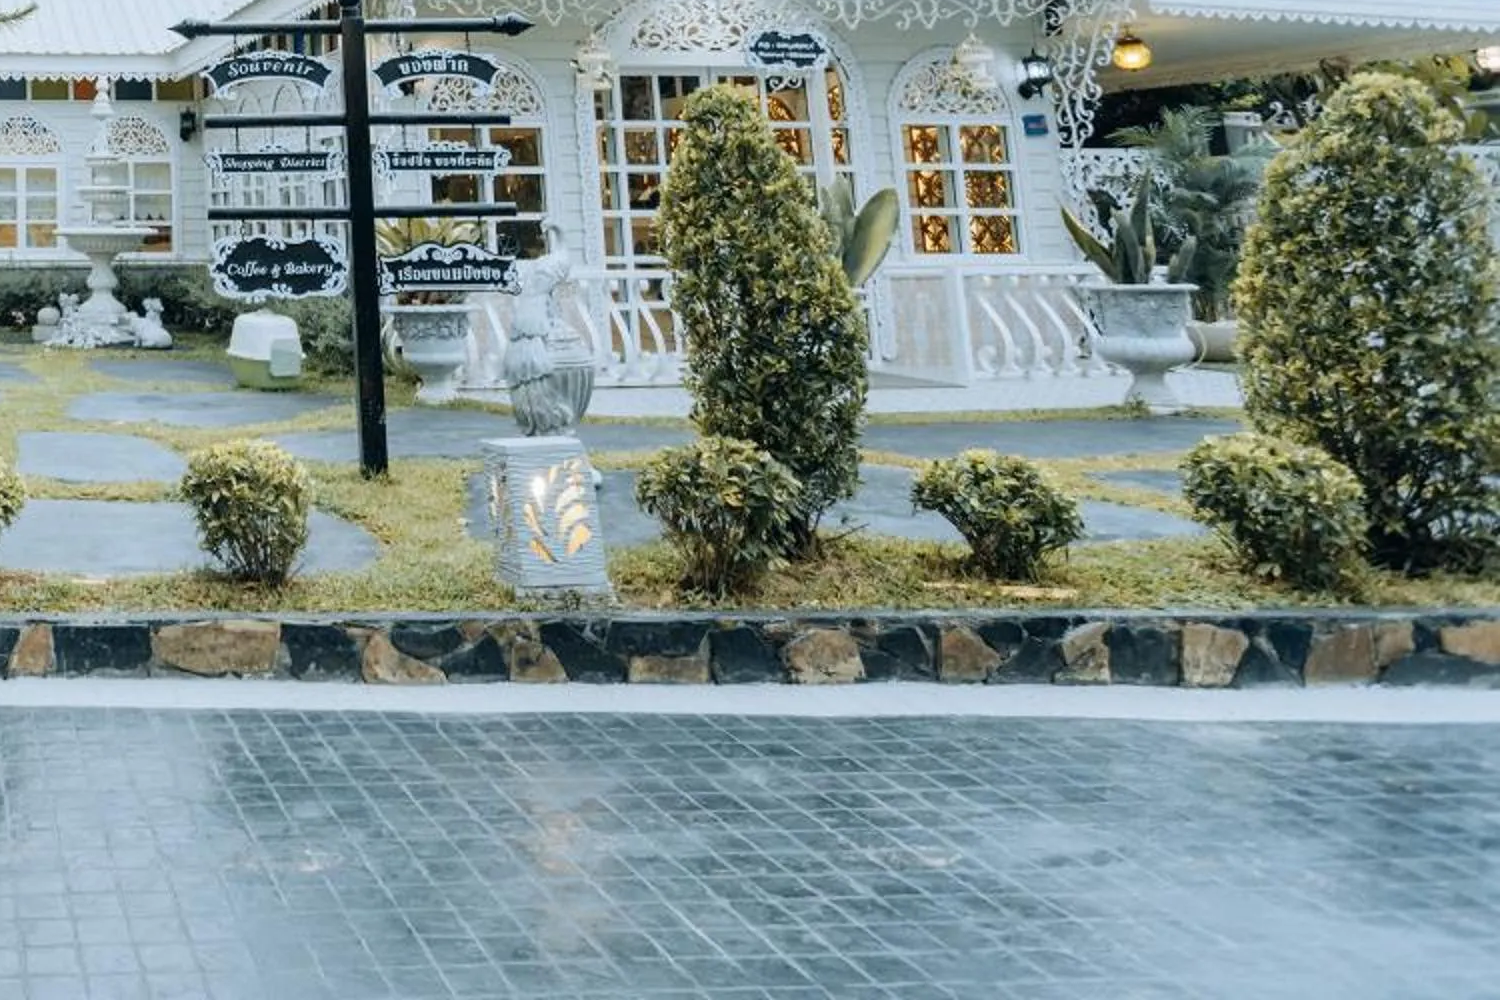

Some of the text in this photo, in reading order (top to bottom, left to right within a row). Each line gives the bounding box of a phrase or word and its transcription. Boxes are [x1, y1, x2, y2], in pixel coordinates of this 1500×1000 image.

[227, 60, 315, 79] Souvenir
[398, 56, 469, 75] ของฝาก
[223, 157, 326, 171] Shopping District
[226, 260, 334, 279] Coffee & Bakery
